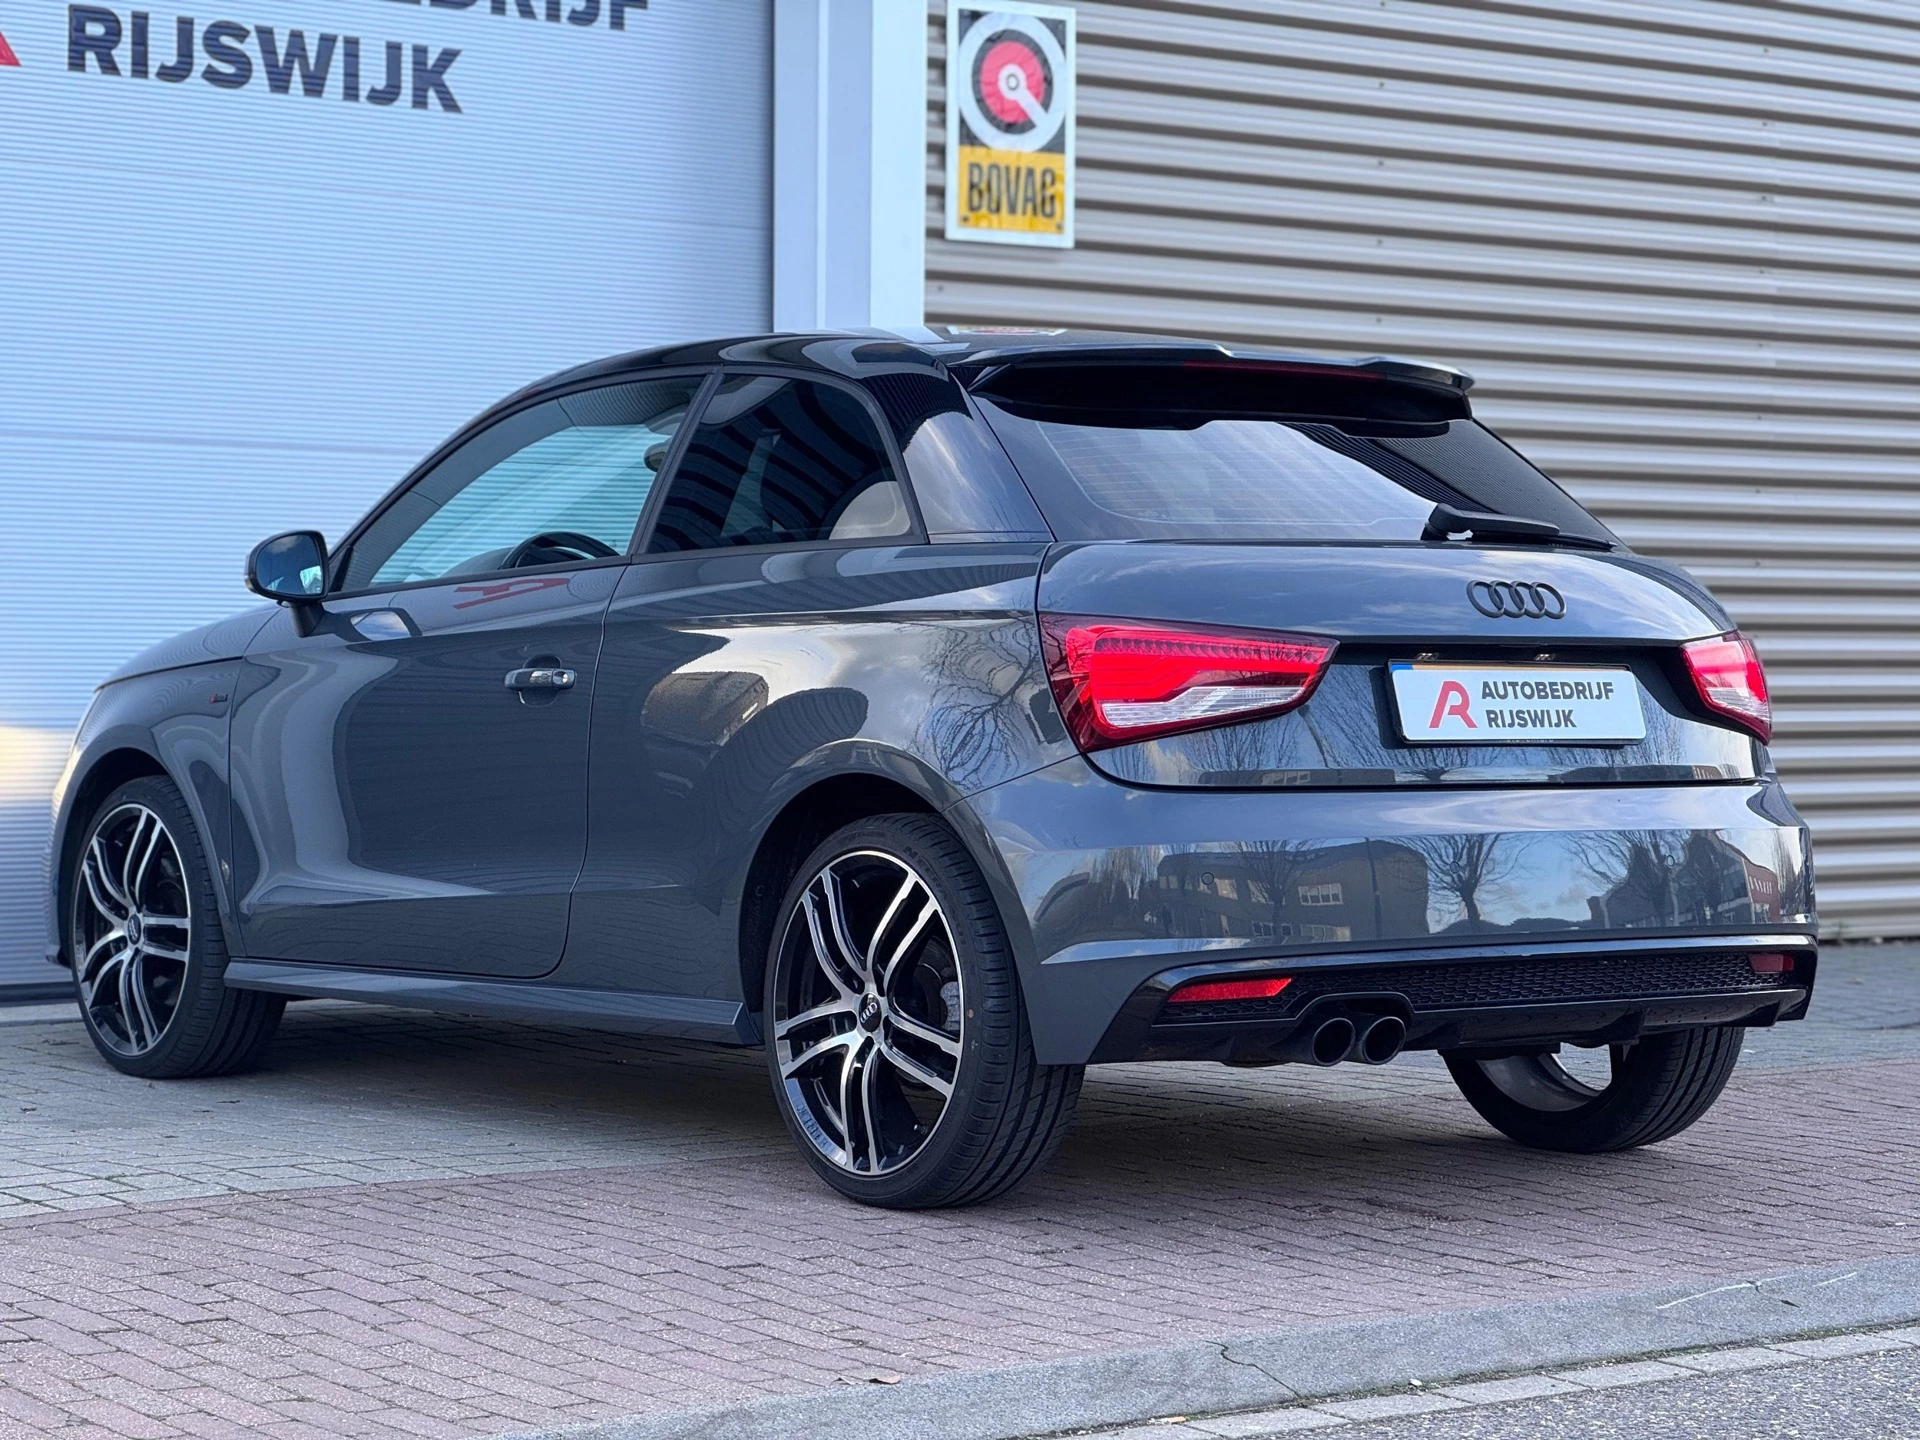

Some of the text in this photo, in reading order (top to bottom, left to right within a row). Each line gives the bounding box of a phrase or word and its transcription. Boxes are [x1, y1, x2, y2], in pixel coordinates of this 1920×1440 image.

[67, 3, 464, 115] RIJSWIJK
[967, 162, 1056, 219] BOVAG
[1481, 680, 1615, 700] AUTOBEDRIJF
[1485, 709, 1578, 728] RIJSWIJK
